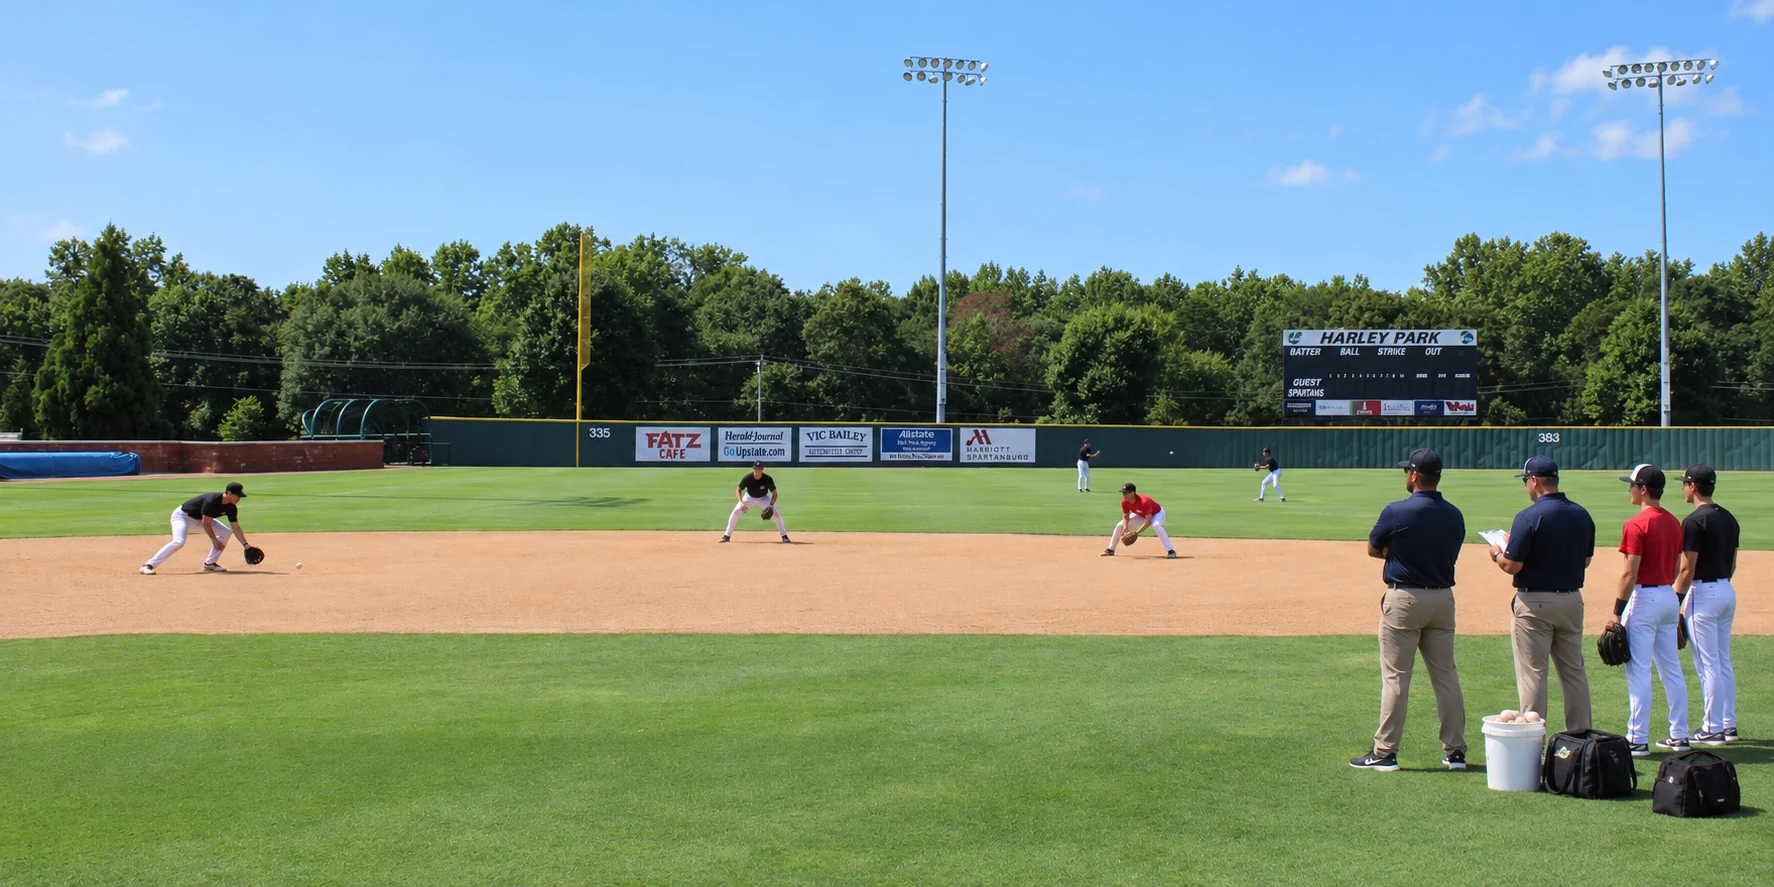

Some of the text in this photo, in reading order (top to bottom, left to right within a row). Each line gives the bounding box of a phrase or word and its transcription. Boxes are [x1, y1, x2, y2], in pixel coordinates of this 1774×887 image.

[1320, 332, 1441, 344] HARLEY PARK
[1290, 348, 1321, 356] BATTER
[1340, 348, 1360, 356] BALL
[1378, 348, 1406, 356] STRIKE
[1425, 348, 1442, 356] OUT
[1293, 378, 1322, 387] GUEST
[589, 428, 611, 438] 335
[725, 431, 783, 442] Herald-Journal
[806, 430, 867, 442] VIC BAILEY
[899, 430, 935, 438] Allstate
[1538, 432, 1560, 443] 383
[645, 430, 702, 448] FATZ
[659, 449, 686, 459] CAFE
